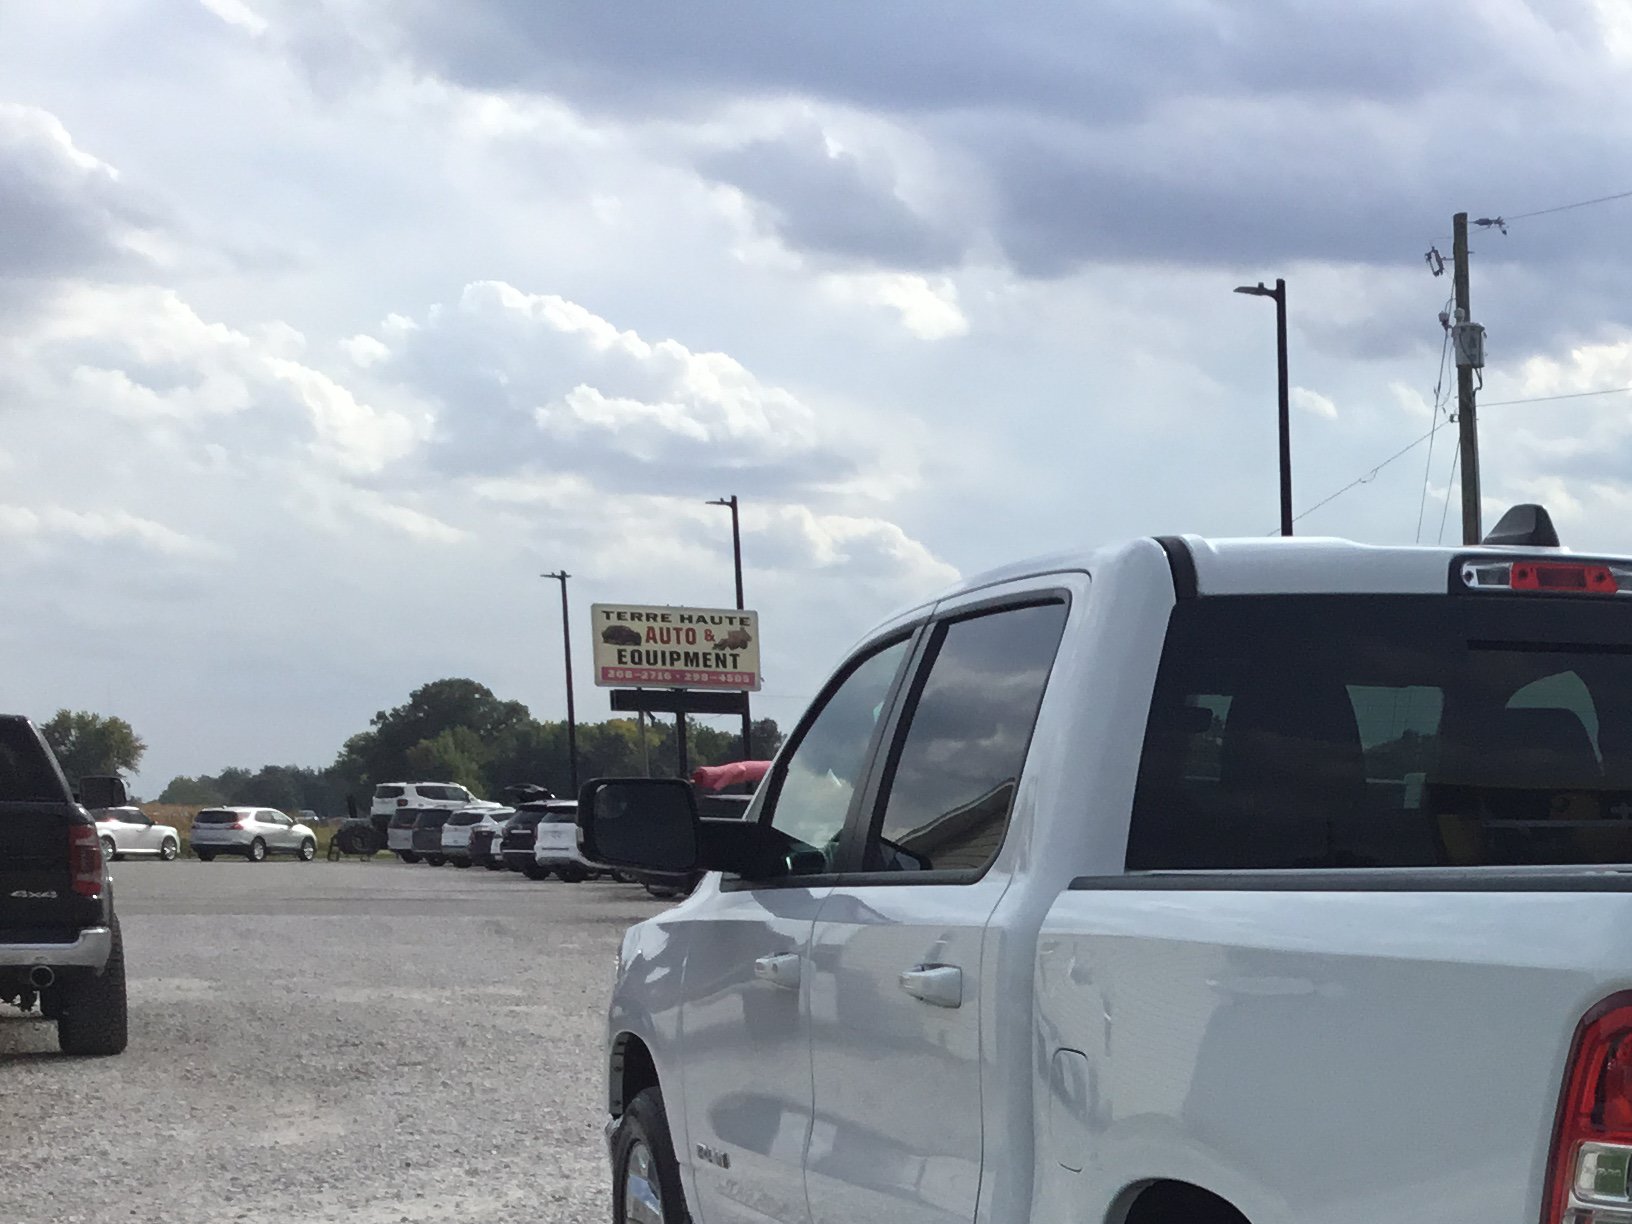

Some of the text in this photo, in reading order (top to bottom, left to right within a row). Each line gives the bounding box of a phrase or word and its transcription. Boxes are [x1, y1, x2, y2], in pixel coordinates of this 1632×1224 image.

[602, 610, 751, 626] TERRE HAUTE
[645, 626, 716, 645] AUTO &
[617, 648, 740, 669] EQUIPMENT
